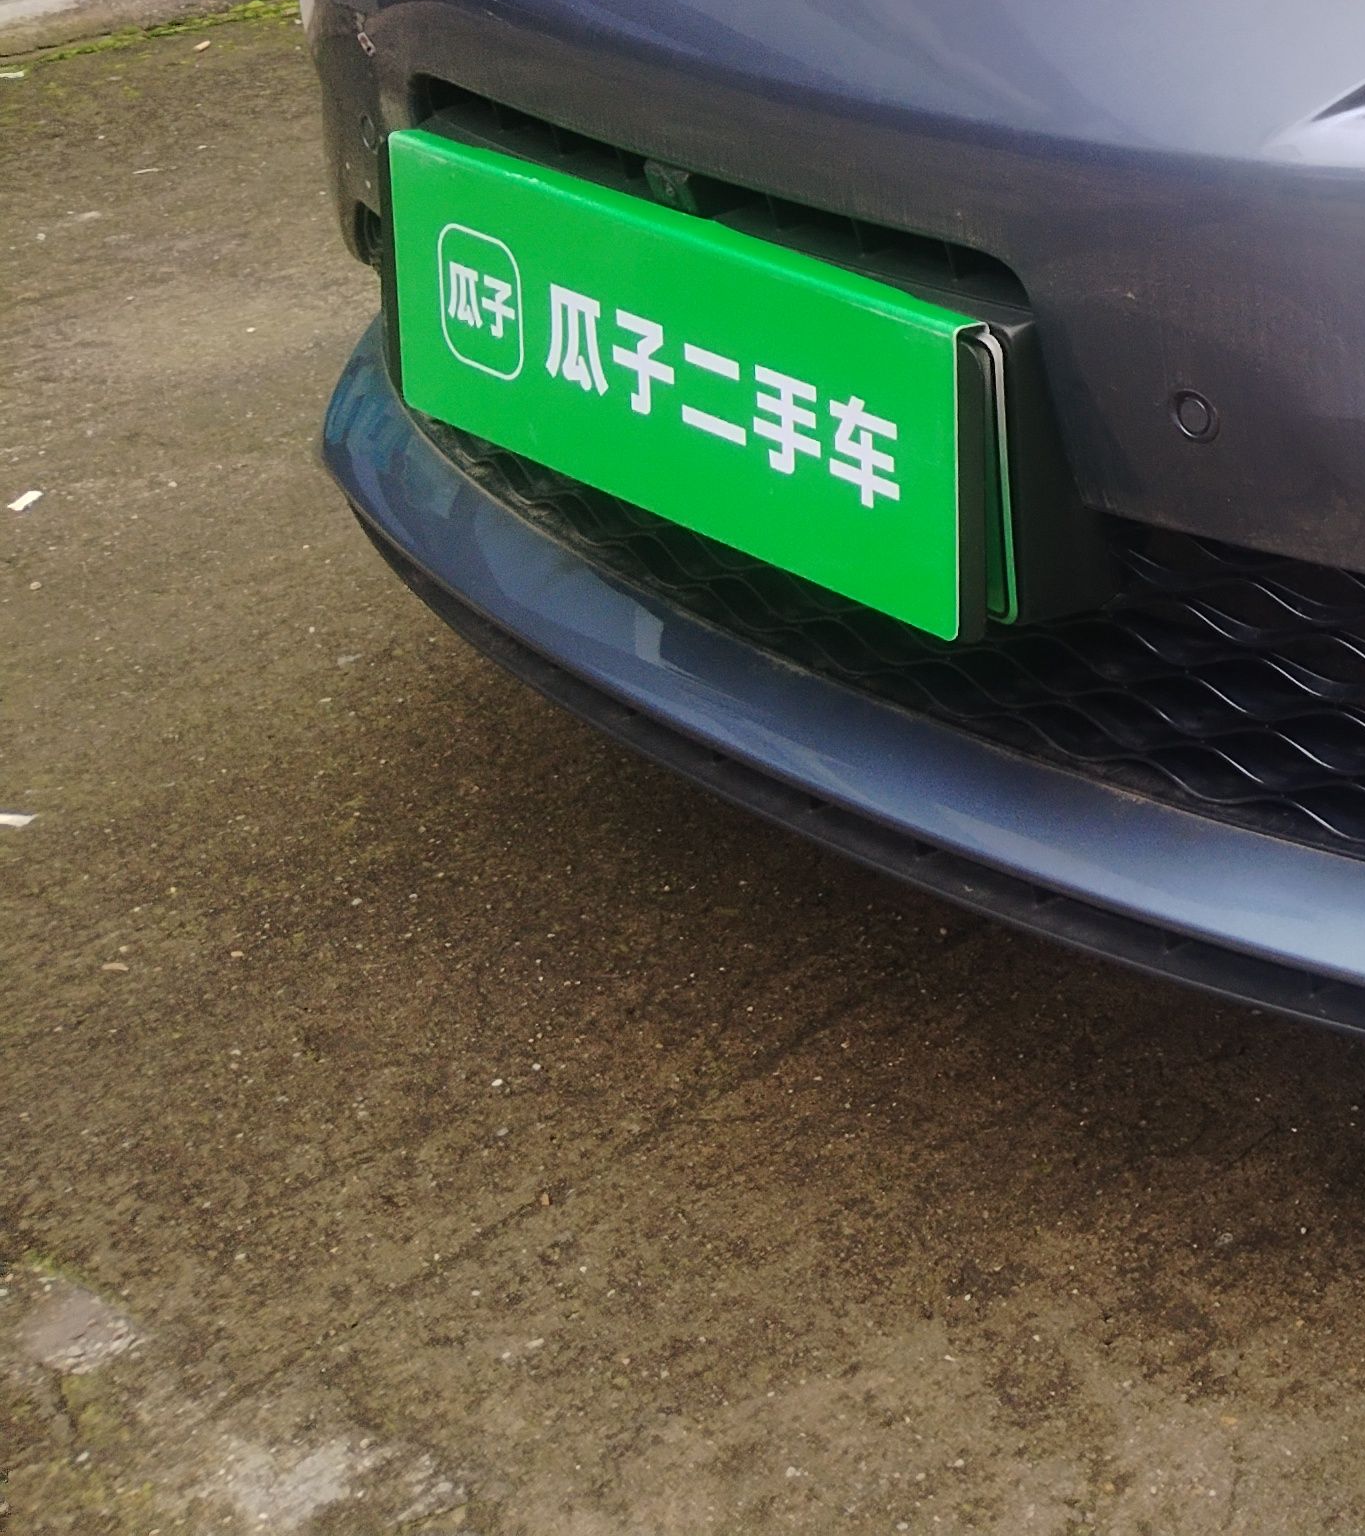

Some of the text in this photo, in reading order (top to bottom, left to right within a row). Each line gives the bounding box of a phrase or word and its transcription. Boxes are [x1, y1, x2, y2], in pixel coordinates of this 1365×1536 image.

[448, 261, 516, 339] 瓜子
[546, 283, 902, 509] 瓜子二手车
